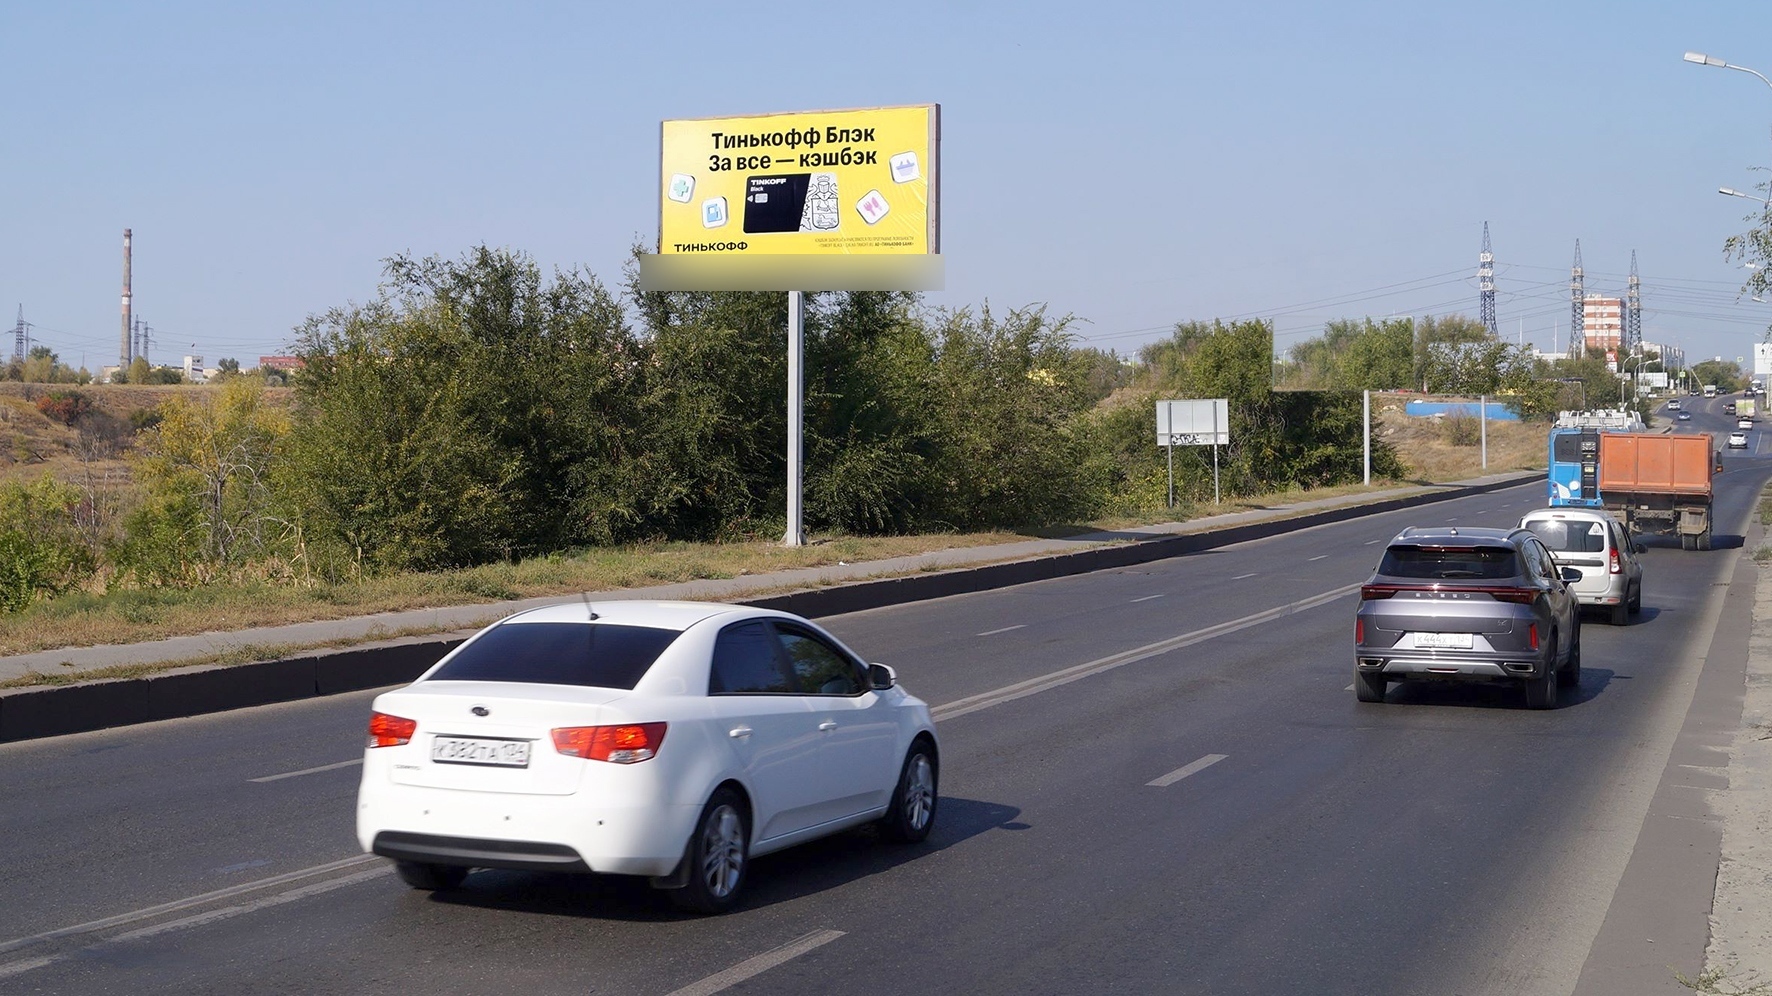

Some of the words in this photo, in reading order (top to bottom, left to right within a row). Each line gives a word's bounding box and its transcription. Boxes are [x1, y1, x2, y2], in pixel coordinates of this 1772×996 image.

[712, 127, 821, 149] Тинькофф
[826, 126, 875, 144] Блэк
[708, 155, 732, 171] За
[736, 155, 771, 171] все
[799, 147, 877, 168] кэшбэк
[750, 178, 787, 186] TINKOFF
[674, 241, 748, 252] ТИНЬКОФФ
